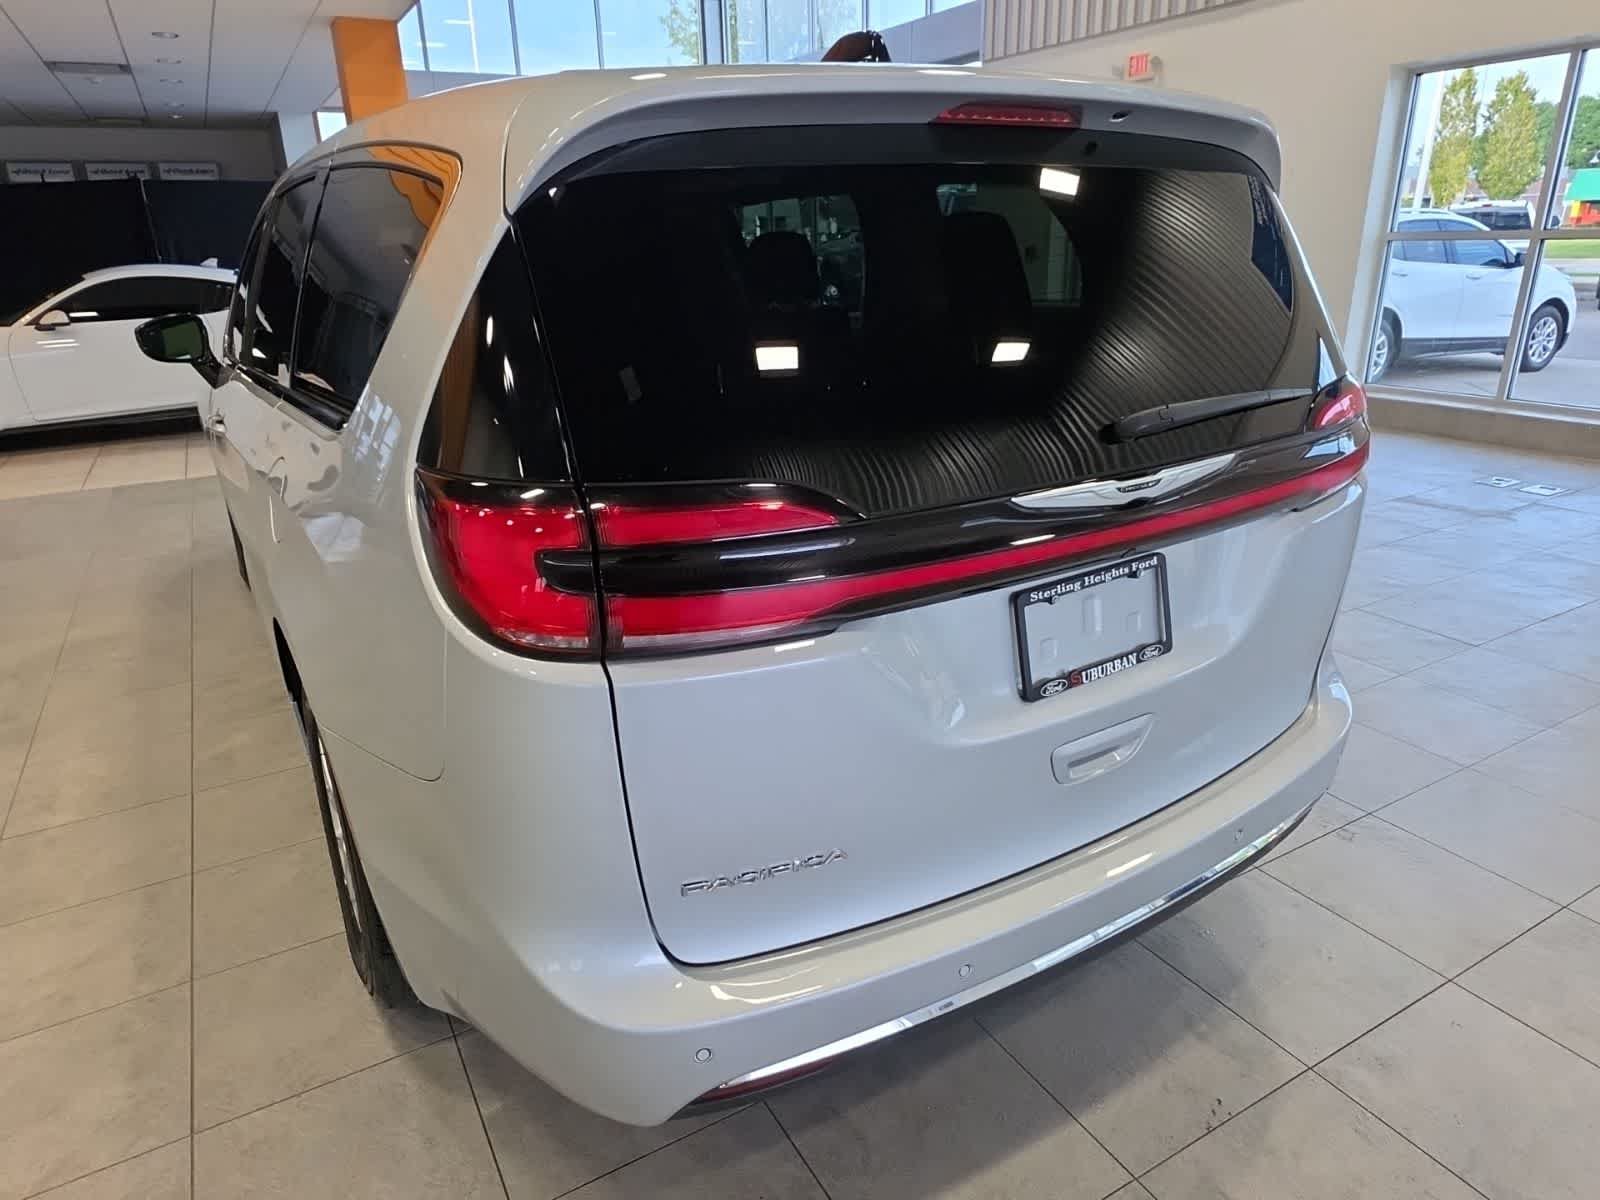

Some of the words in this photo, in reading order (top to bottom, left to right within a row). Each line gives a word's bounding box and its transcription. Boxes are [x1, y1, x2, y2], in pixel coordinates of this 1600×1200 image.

[1128, 55, 1149, 77] EXIT
[1030, 580, 1082, 602] Sterling
[1083, 566, 1129, 587] Heights
[1131, 556, 1158, 572] Ford
[1070, 653, 1137, 686] SUBURBAN
[680, 848, 848, 897] PACIFICA
